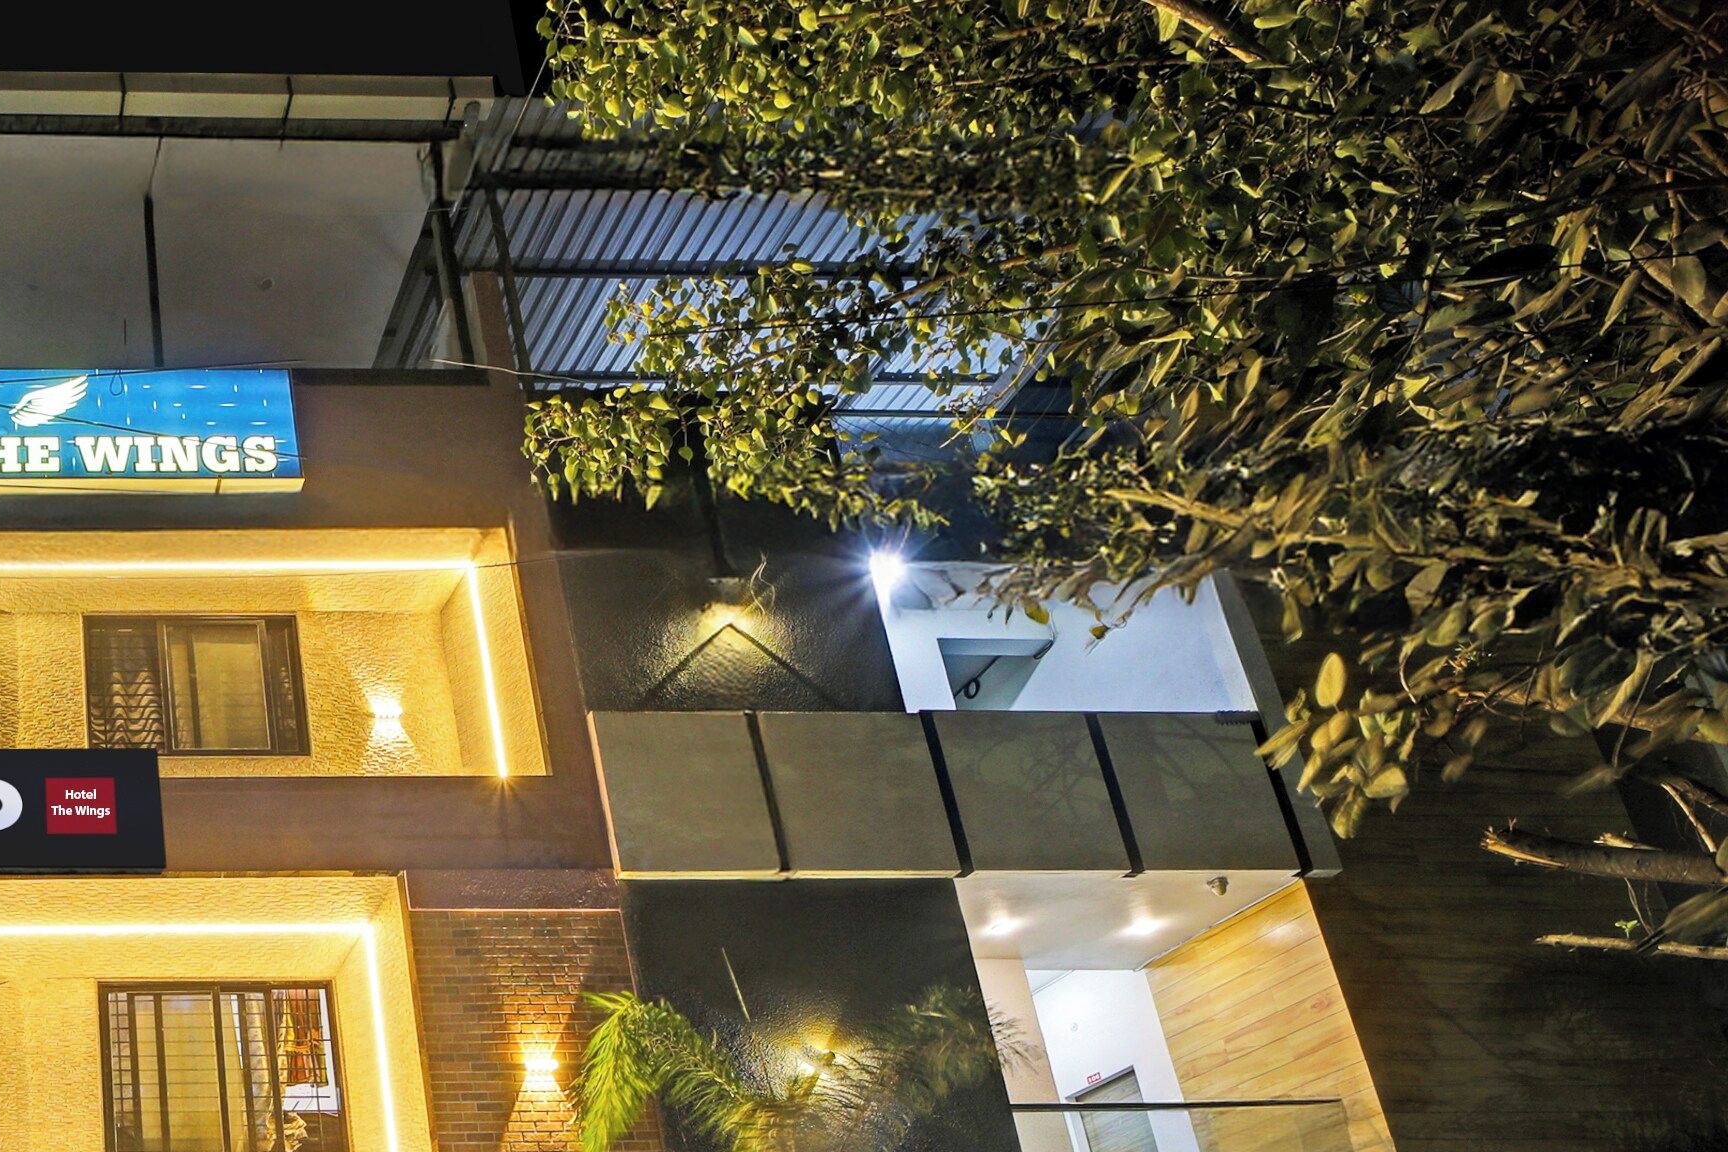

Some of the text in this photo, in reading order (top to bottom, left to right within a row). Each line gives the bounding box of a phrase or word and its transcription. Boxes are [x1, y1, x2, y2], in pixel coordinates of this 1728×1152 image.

[75, 435, 278, 473] WINGS
[64, 788, 97, 800] Hotel
[50, 804, 73, 816] The
